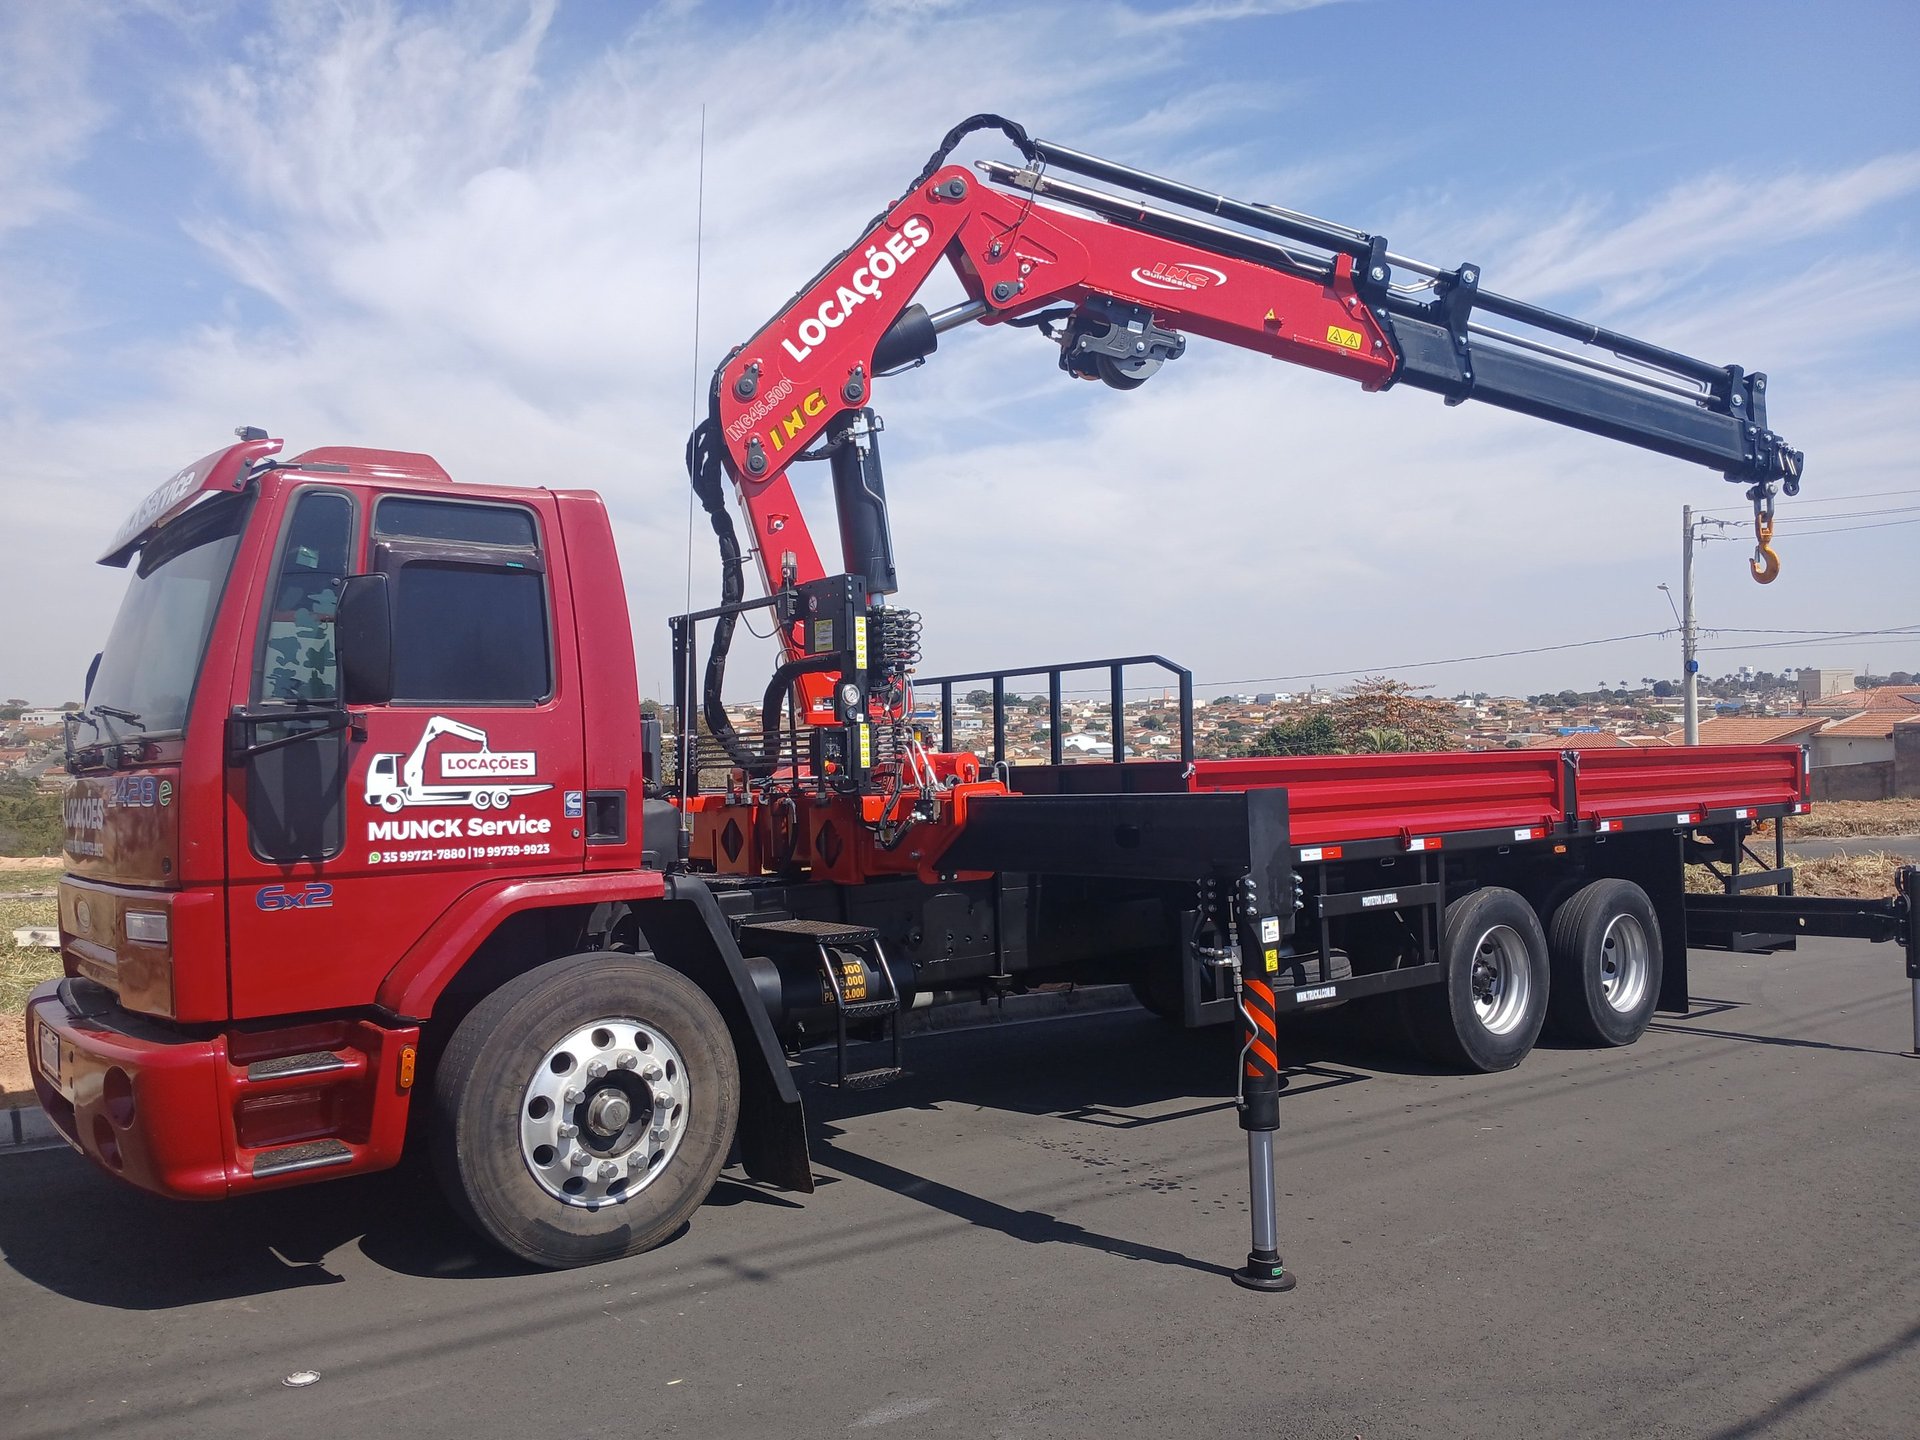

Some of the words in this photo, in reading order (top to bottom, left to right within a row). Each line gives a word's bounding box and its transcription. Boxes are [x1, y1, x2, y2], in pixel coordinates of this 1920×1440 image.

[1152, 262, 1210, 287] ING
[781, 218, 930, 363] LOCAÇÕES
[726, 379, 793, 442] ING45.500
[769, 387, 828, 452] ING
[447, 756, 529, 773] LOCAÇÕES
[368, 818, 463, 842] MUNCK
[467, 814, 551, 837] Service
[382, 851, 398, 864] 35
[400, 848, 466, 862] 99721-7880
[473, 846, 485, 859] 19
[486, 843, 550, 857] 99739-9923
[256, 882, 334, 911] 6x2
